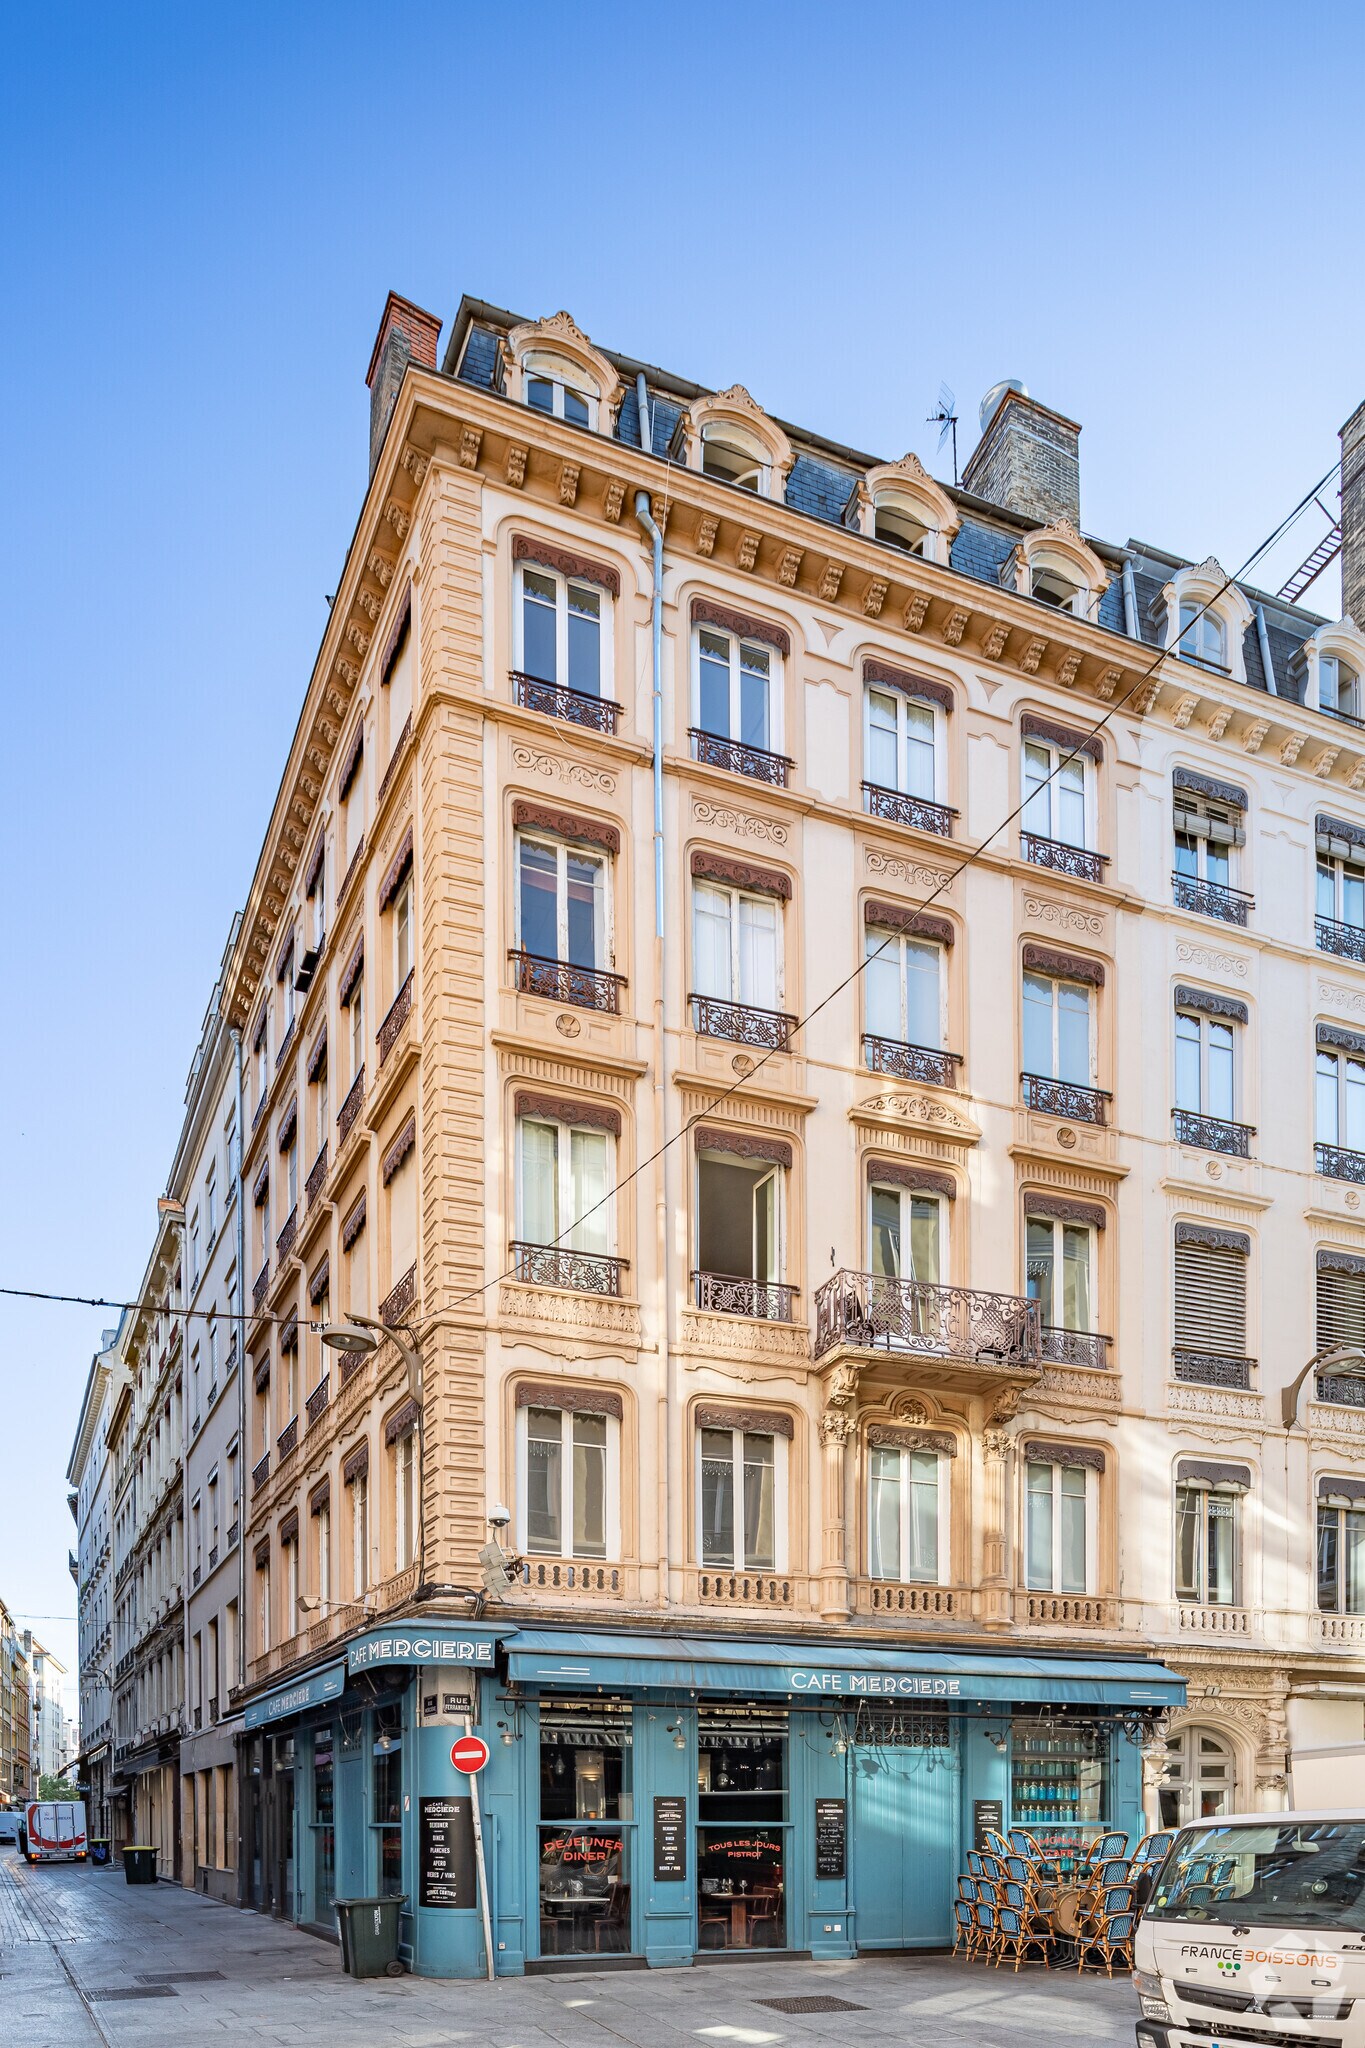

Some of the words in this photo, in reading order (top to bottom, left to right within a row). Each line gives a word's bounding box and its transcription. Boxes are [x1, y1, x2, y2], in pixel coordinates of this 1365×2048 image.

[350, 1646, 367, 1667] CAFE
[368, 1639, 492, 1661] MERCIERE
[791, 1672, 842, 1690] CAFE
[849, 1674, 961, 1695] MERCIERE
[268, 1700, 281, 1716] CAFE
[450, 1697, 468, 1705] RUE
[543, 1836, 624, 1852] DEJEUNER
[708, 1841, 733, 1852] TOUS
[751, 1841, 781, 1852] JOURS
[1029, 1836, 1091, 1850] LMONADE
[563, 1851, 606, 1861] DINER
[1181, 1946, 1243, 1961] FRANCE
[1244, 1950, 1337, 1969] BOISSONS
